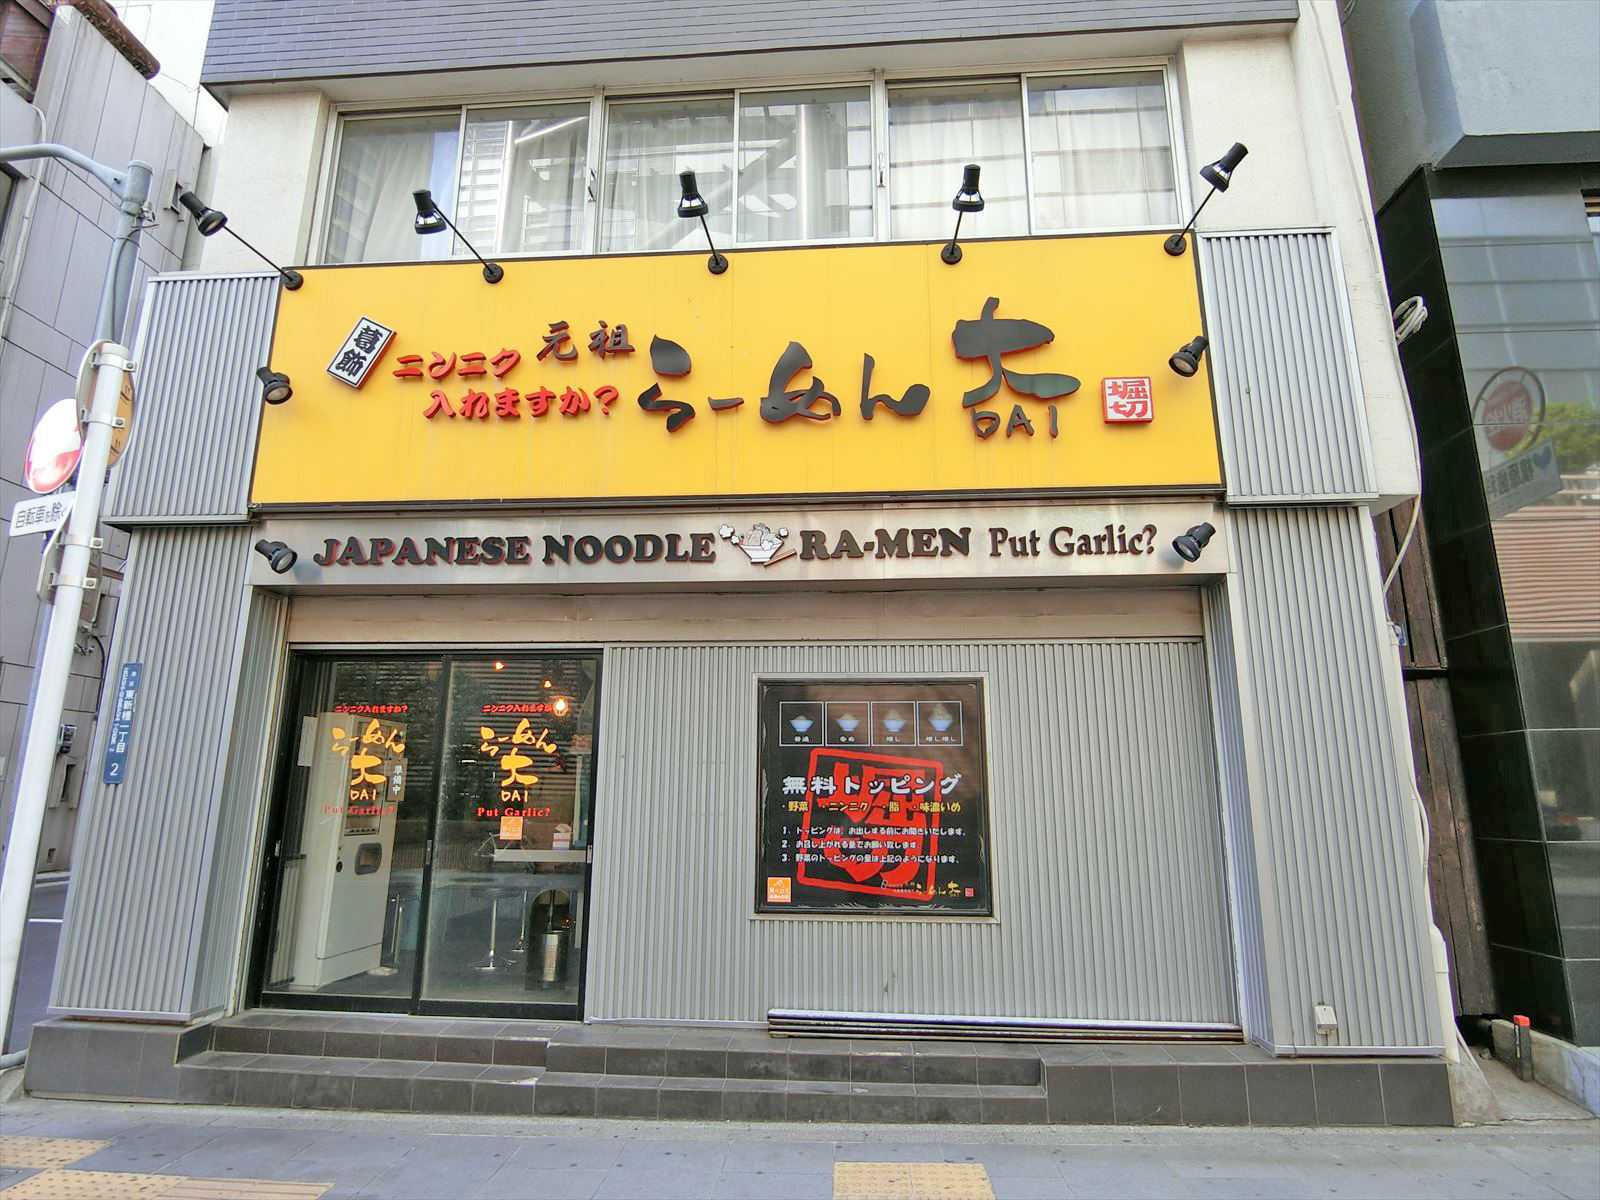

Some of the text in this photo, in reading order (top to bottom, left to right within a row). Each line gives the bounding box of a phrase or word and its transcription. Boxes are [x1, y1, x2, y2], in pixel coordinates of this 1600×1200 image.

[335, 324, 384, 377] 葛飾
[536, 320, 635, 361] 元祖
[393, 348, 521, 380] ニンニク
[423, 385, 619, 419] 入れますか?
[1107, 378, 1149, 419] 堀切
[971, 403, 1059, 440] DAI
[15, 501, 68, 529] 自転車を除く
[313, 532, 718, 566] JAPANESE NOODLE
[799, 523, 1158, 560] RA-MEN Put Garlic?
[331, 718, 406, 757] らーめん
[480, 717, 557, 757] らーめん
[109, 762, 119, 776] 2
[350, 747, 386, 785] 大
[501, 747, 539, 787] 大
[350, 789, 377, 801] DAI
[501, 790, 528, 803] DAI
[782, 773, 962, 796] 無料トッピング
[476, 807, 551, 817] Put Garlic?
